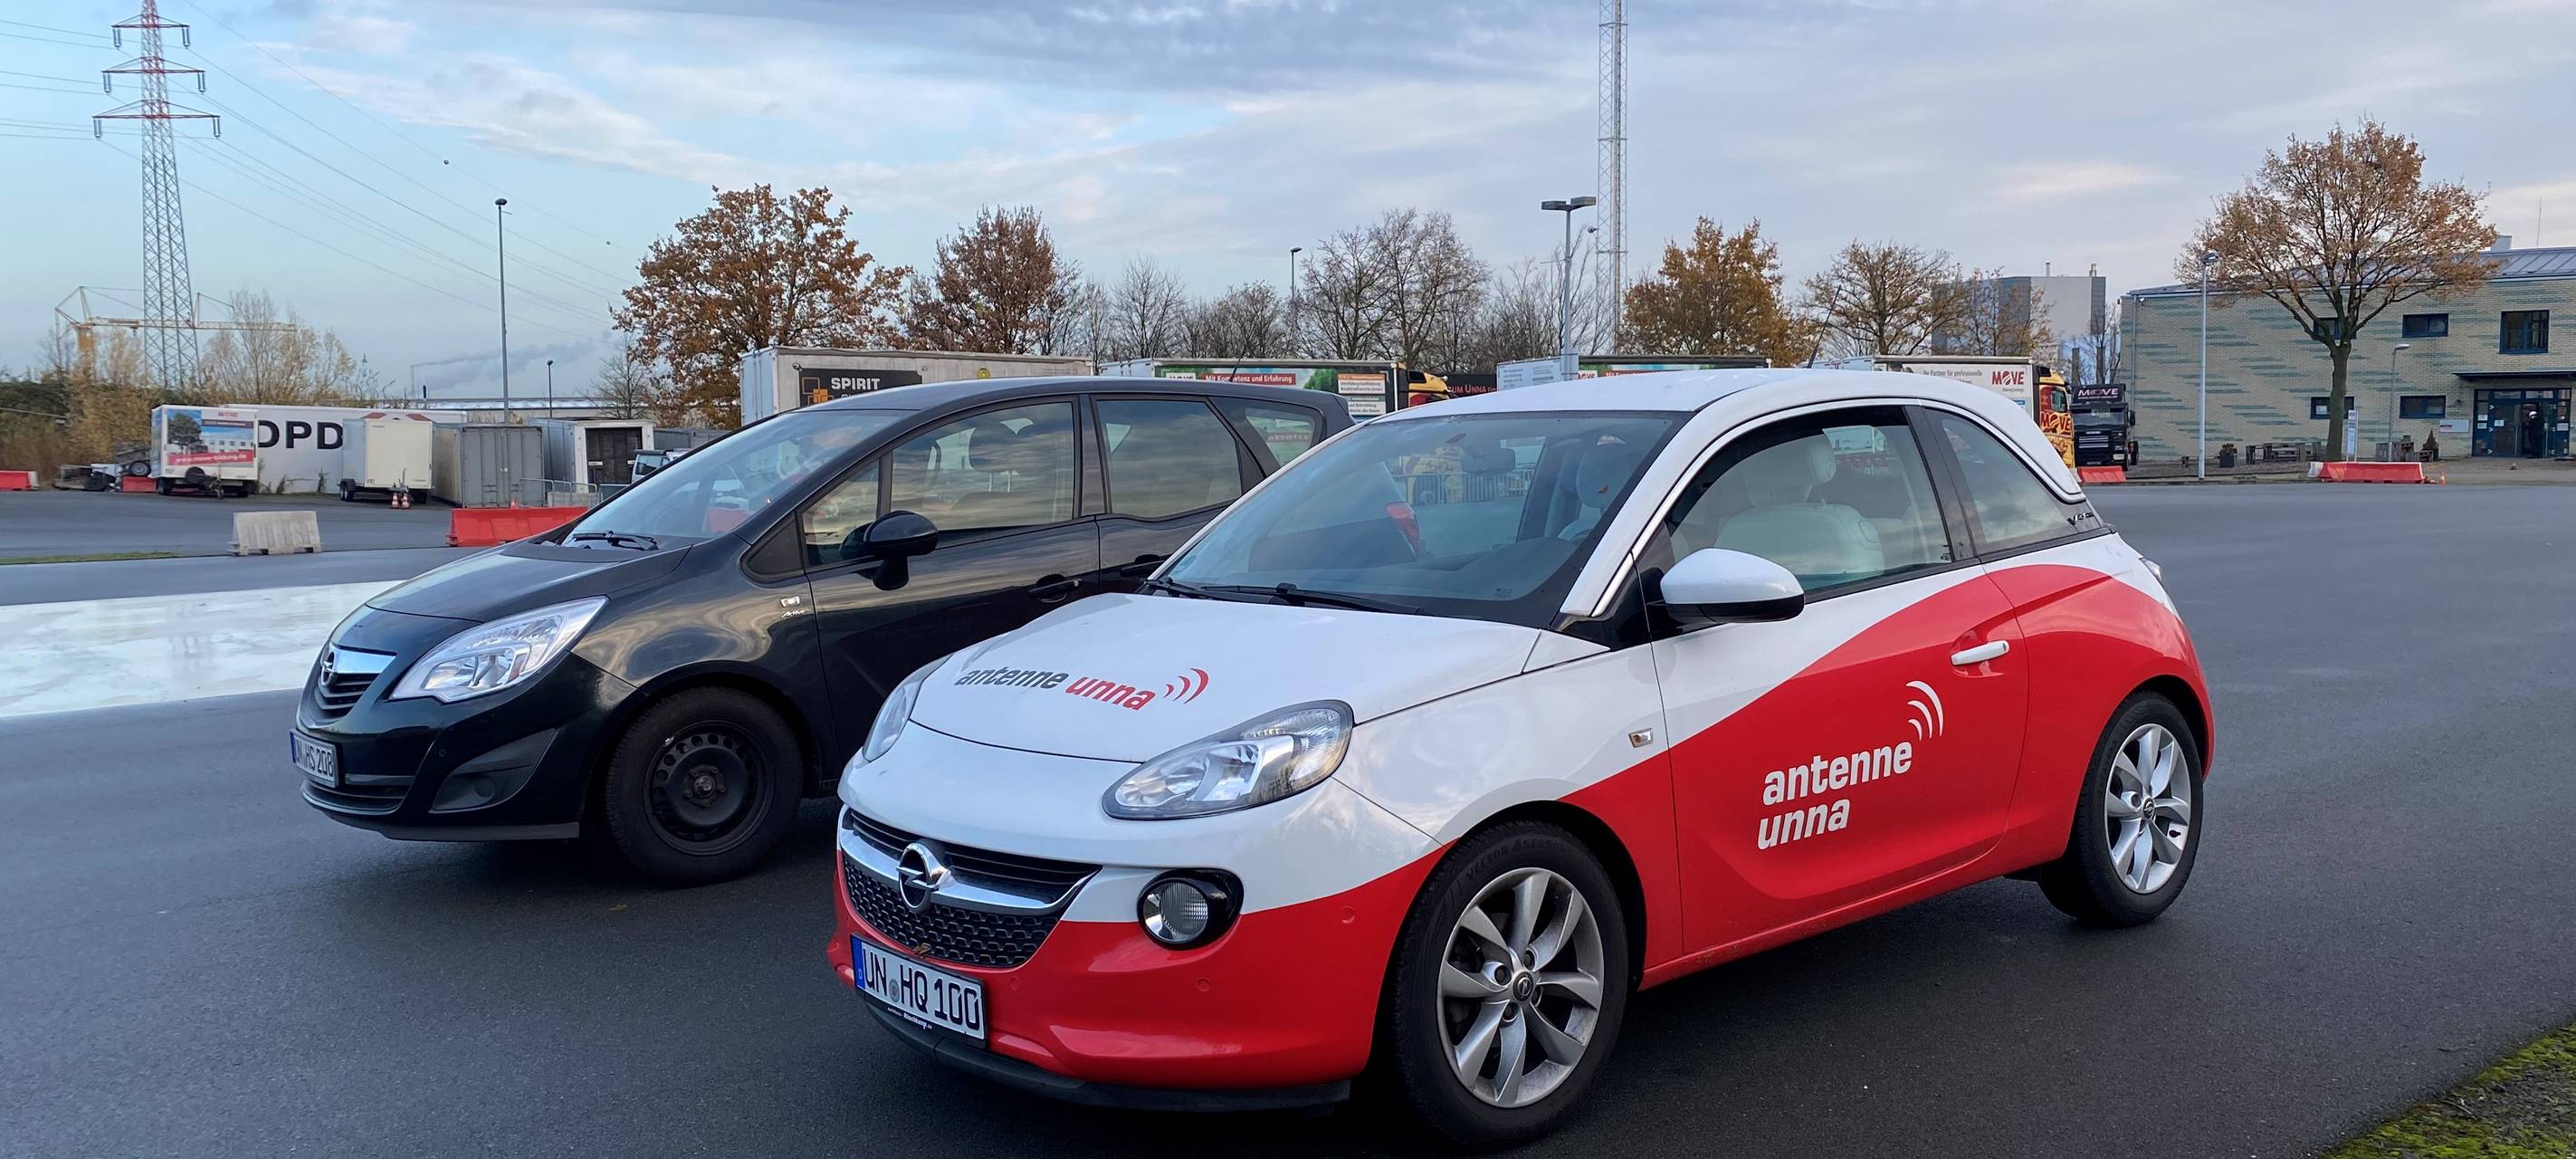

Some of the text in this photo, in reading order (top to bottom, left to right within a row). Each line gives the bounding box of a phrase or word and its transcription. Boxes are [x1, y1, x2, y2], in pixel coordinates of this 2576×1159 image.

[831, 378, 881, 389] SPIRIT
[1251, 374, 1263, 382] und
[1264, 374, 1293, 383] Erfahrung
[1991, 370, 2025, 385] MOVE
[2077, 388, 2119, 397] MOVE
[258, 419, 344, 450] DPD
[2040, 411, 2072, 431] MOVE
[954, 666, 1157, 711] antenne unna
[316, 748, 334, 777] 208
[1762, 741, 1913, 805] antenne
[1757, 799, 1850, 850] unna
[863, 948, 888, 996] UN
[900, 964, 929, 1014] HQ
[933, 978, 980, 1030] 100
